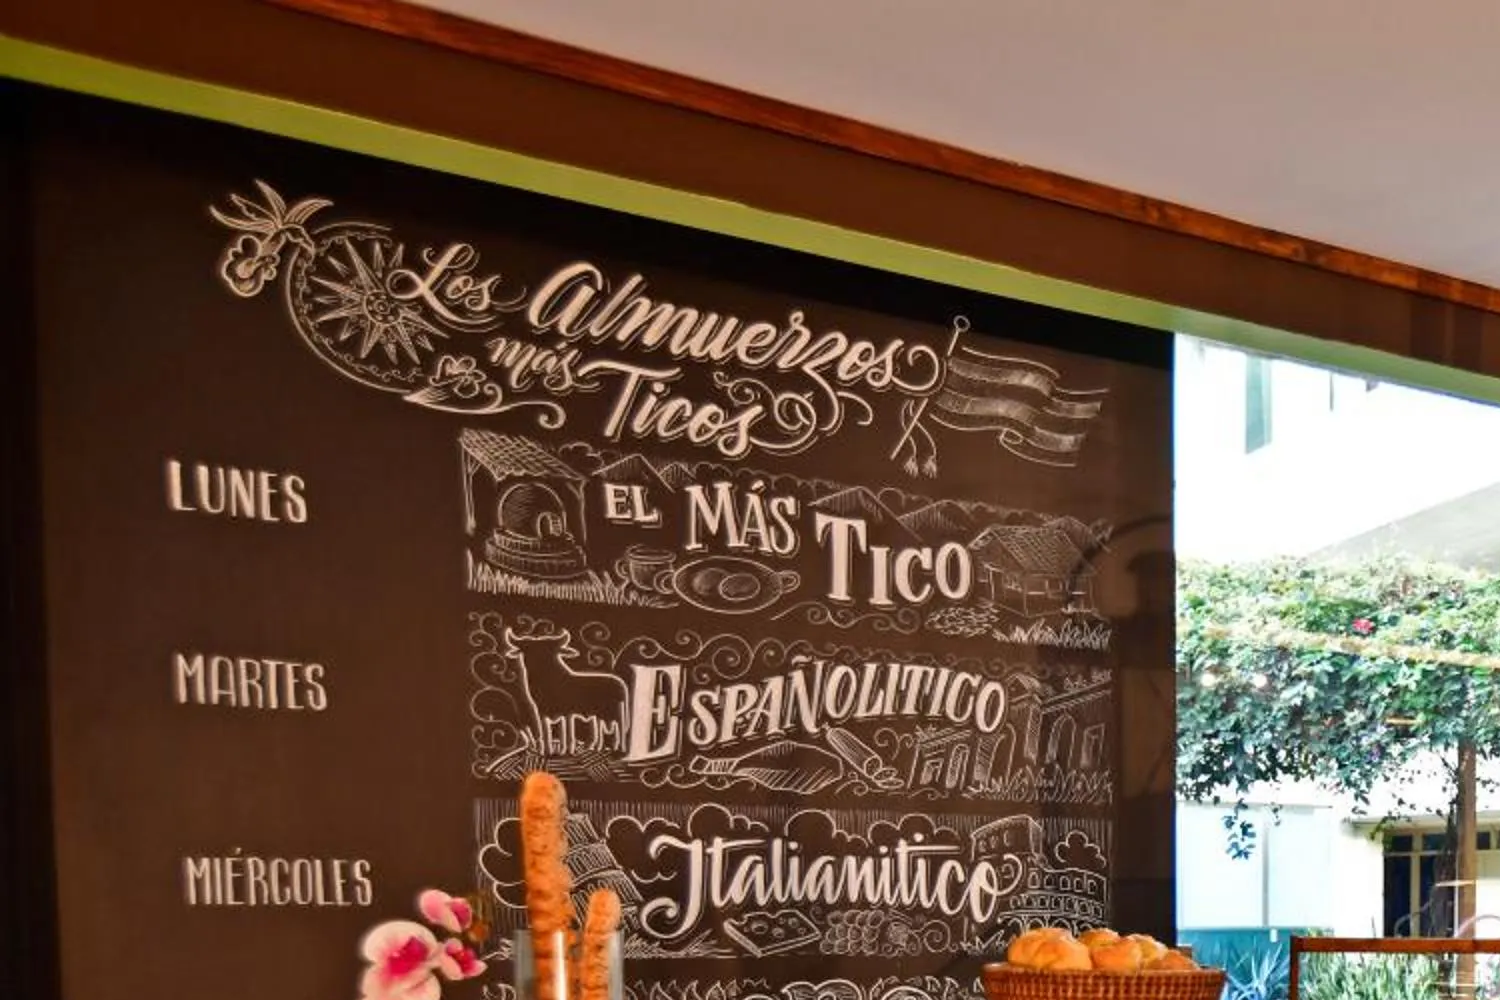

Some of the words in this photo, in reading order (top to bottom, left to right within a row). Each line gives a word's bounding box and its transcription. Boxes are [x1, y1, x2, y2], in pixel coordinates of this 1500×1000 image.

[386, 243, 501, 325] Los
[528, 262, 938, 430] Almuerzos
[488, 338, 580, 389] más
[578, 360, 768, 456] Ticos
[167, 460, 308, 524] LUNES
[604, 483, 661, 524] EL
[684, 480, 797, 555] MÁS
[175, 653, 328, 711] MARTES
[184, 847, 373, 907] MIÉRCOLES
[640, 833, 1021, 940] Italianitico
